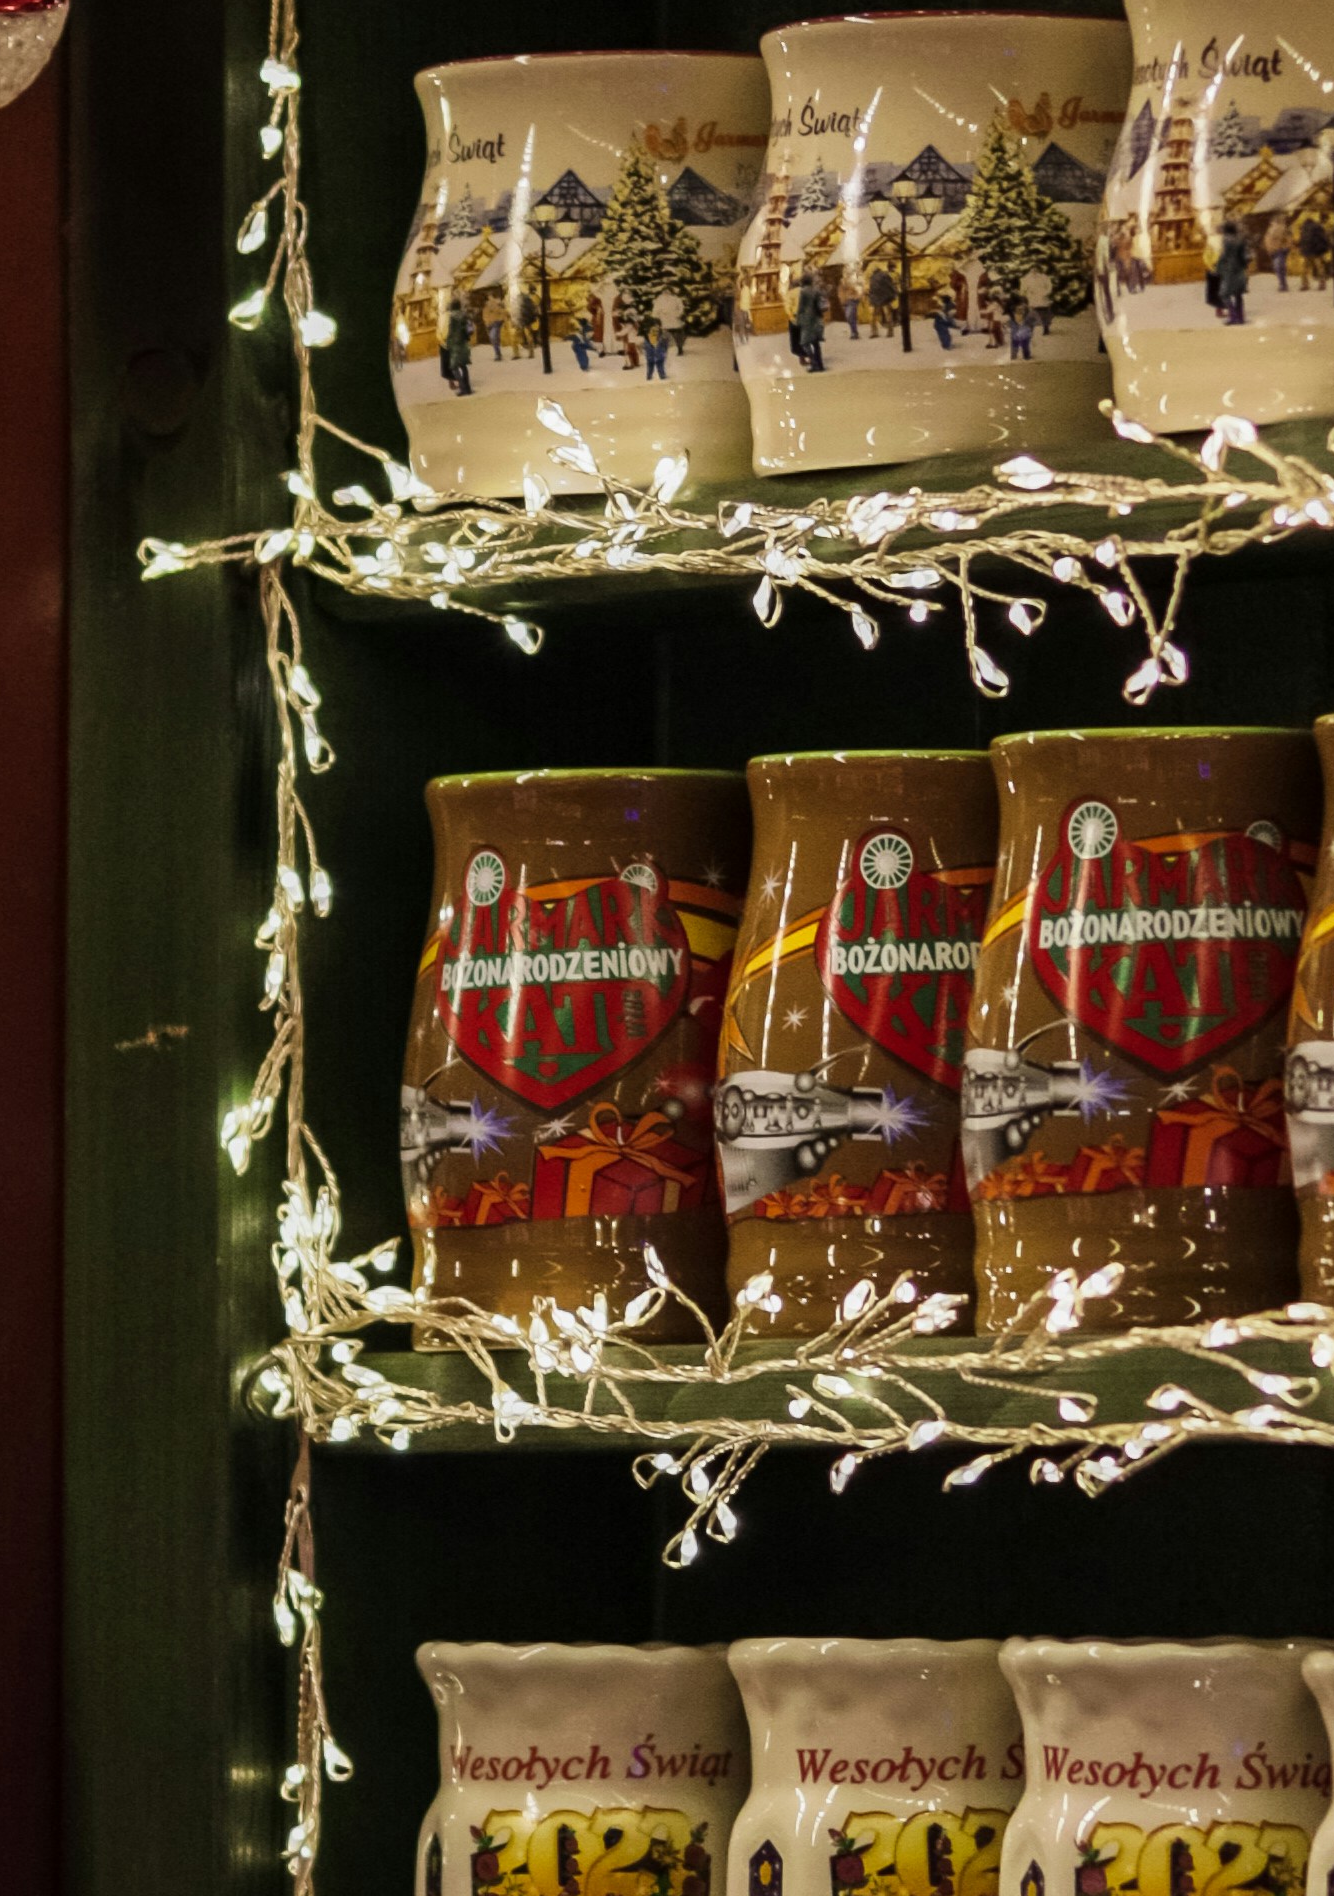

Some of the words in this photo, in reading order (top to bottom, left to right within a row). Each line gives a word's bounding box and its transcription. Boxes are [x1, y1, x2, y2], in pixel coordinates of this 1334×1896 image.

[800, 96, 861, 137] Świąt
[448, 125, 505, 164] Świąt
[443, 1744, 611, 1791] Wesołych
[625, 1733, 733, 1787] Świąt
[796, 1745, 987, 1792] Wesołych
[1043, 1745, 1220, 1799] Wesołych
